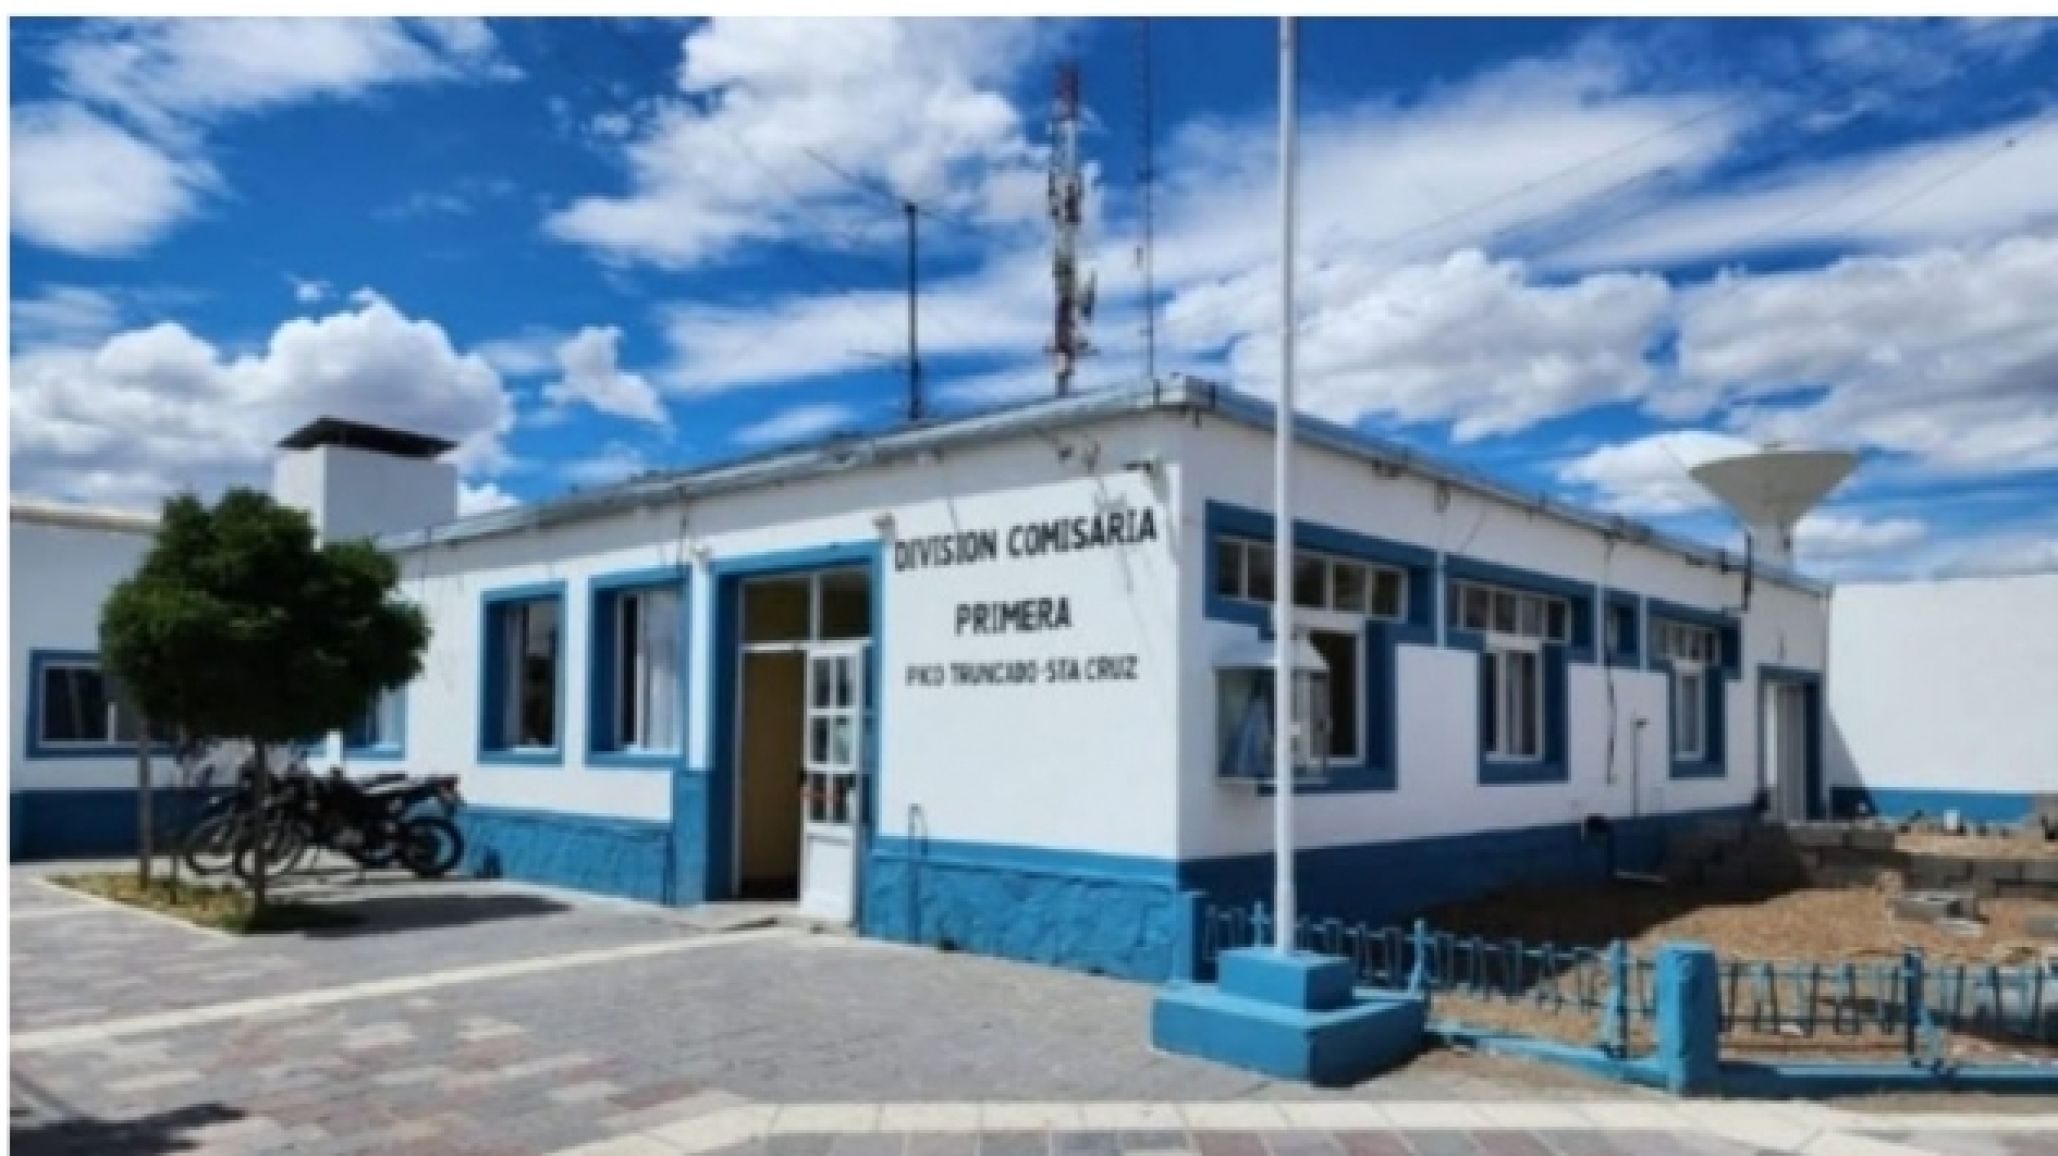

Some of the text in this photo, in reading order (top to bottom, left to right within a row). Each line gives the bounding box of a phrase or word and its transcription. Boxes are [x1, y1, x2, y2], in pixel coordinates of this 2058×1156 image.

[895, 507, 1157, 571] DIVISION COMISARIA
[956, 596, 1072, 635] PRIMERA
[1085, 653, 1140, 681] CRUZ
